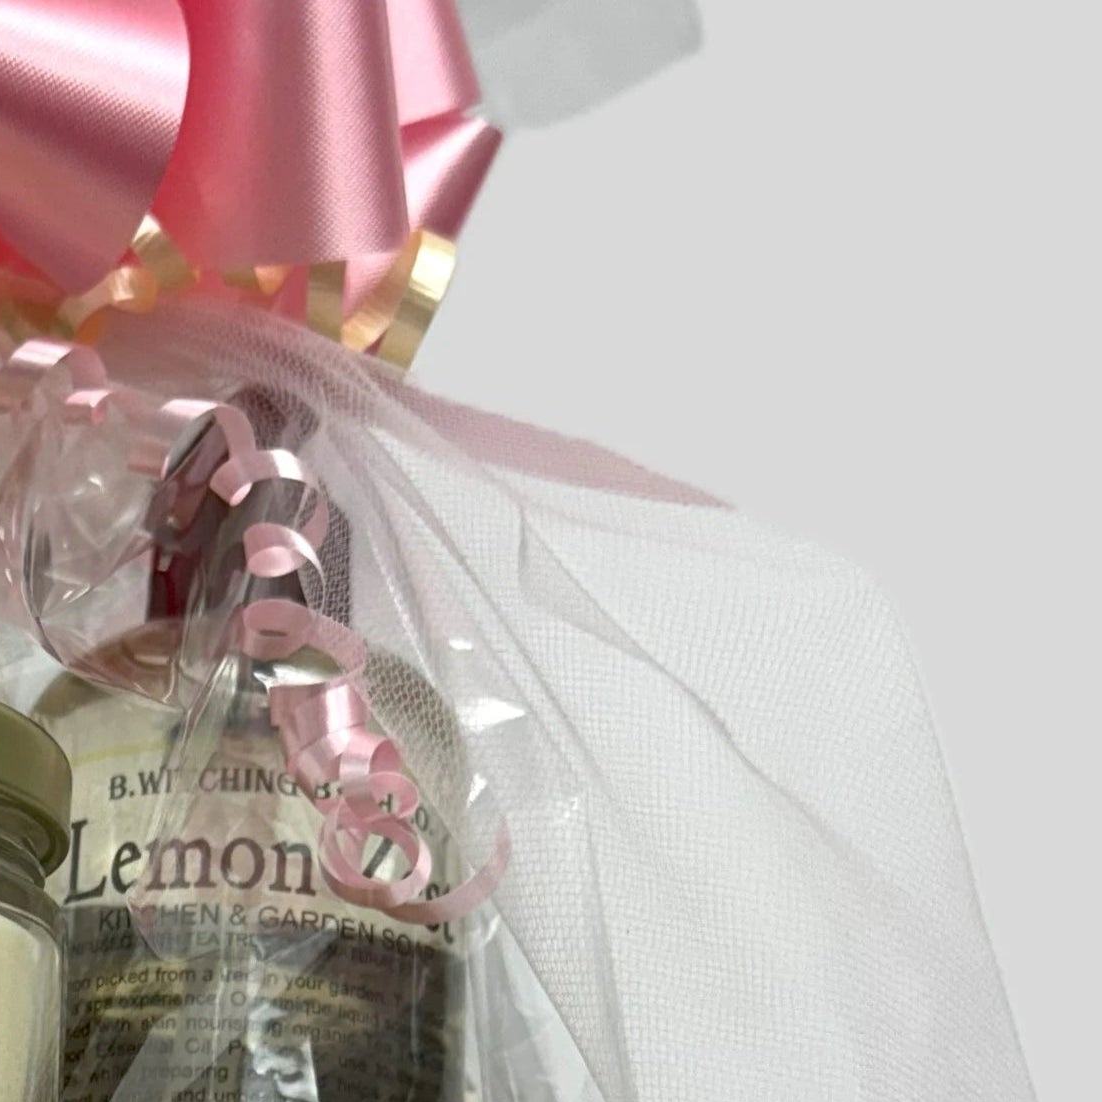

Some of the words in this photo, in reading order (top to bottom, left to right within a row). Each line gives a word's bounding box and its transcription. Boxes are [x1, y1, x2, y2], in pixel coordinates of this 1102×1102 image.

[64, 818, 316, 905] Lemon
[229, 903, 247, 926] &
[258, 906, 374, 945] GARDEN
[156, 966, 197, 983] from
[285, 976, 324, 992] your
